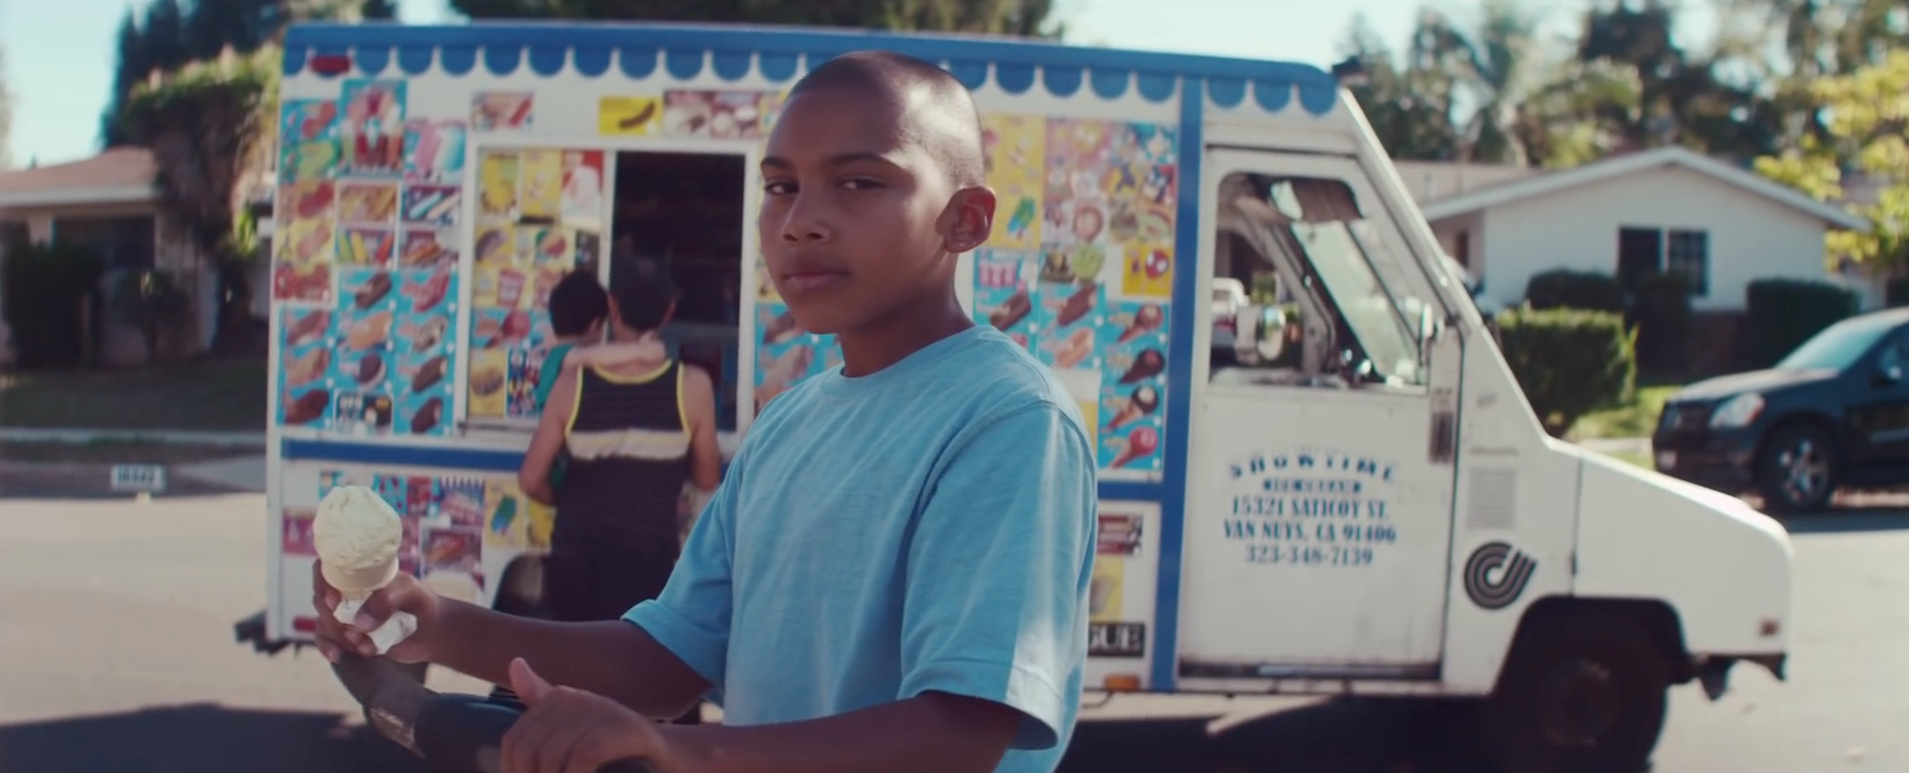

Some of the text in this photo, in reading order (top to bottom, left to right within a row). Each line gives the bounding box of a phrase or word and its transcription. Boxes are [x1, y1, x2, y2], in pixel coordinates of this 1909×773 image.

[1228, 450, 1397, 483] SHOWTIME
[1232, 495, 1285, 517] 15321
[1291, 497, 1361, 519] SATICOY
[1224, 518, 1256, 540] VAN
[1316, 521, 1337, 543] CA
[1343, 523, 1397, 546] 91406
